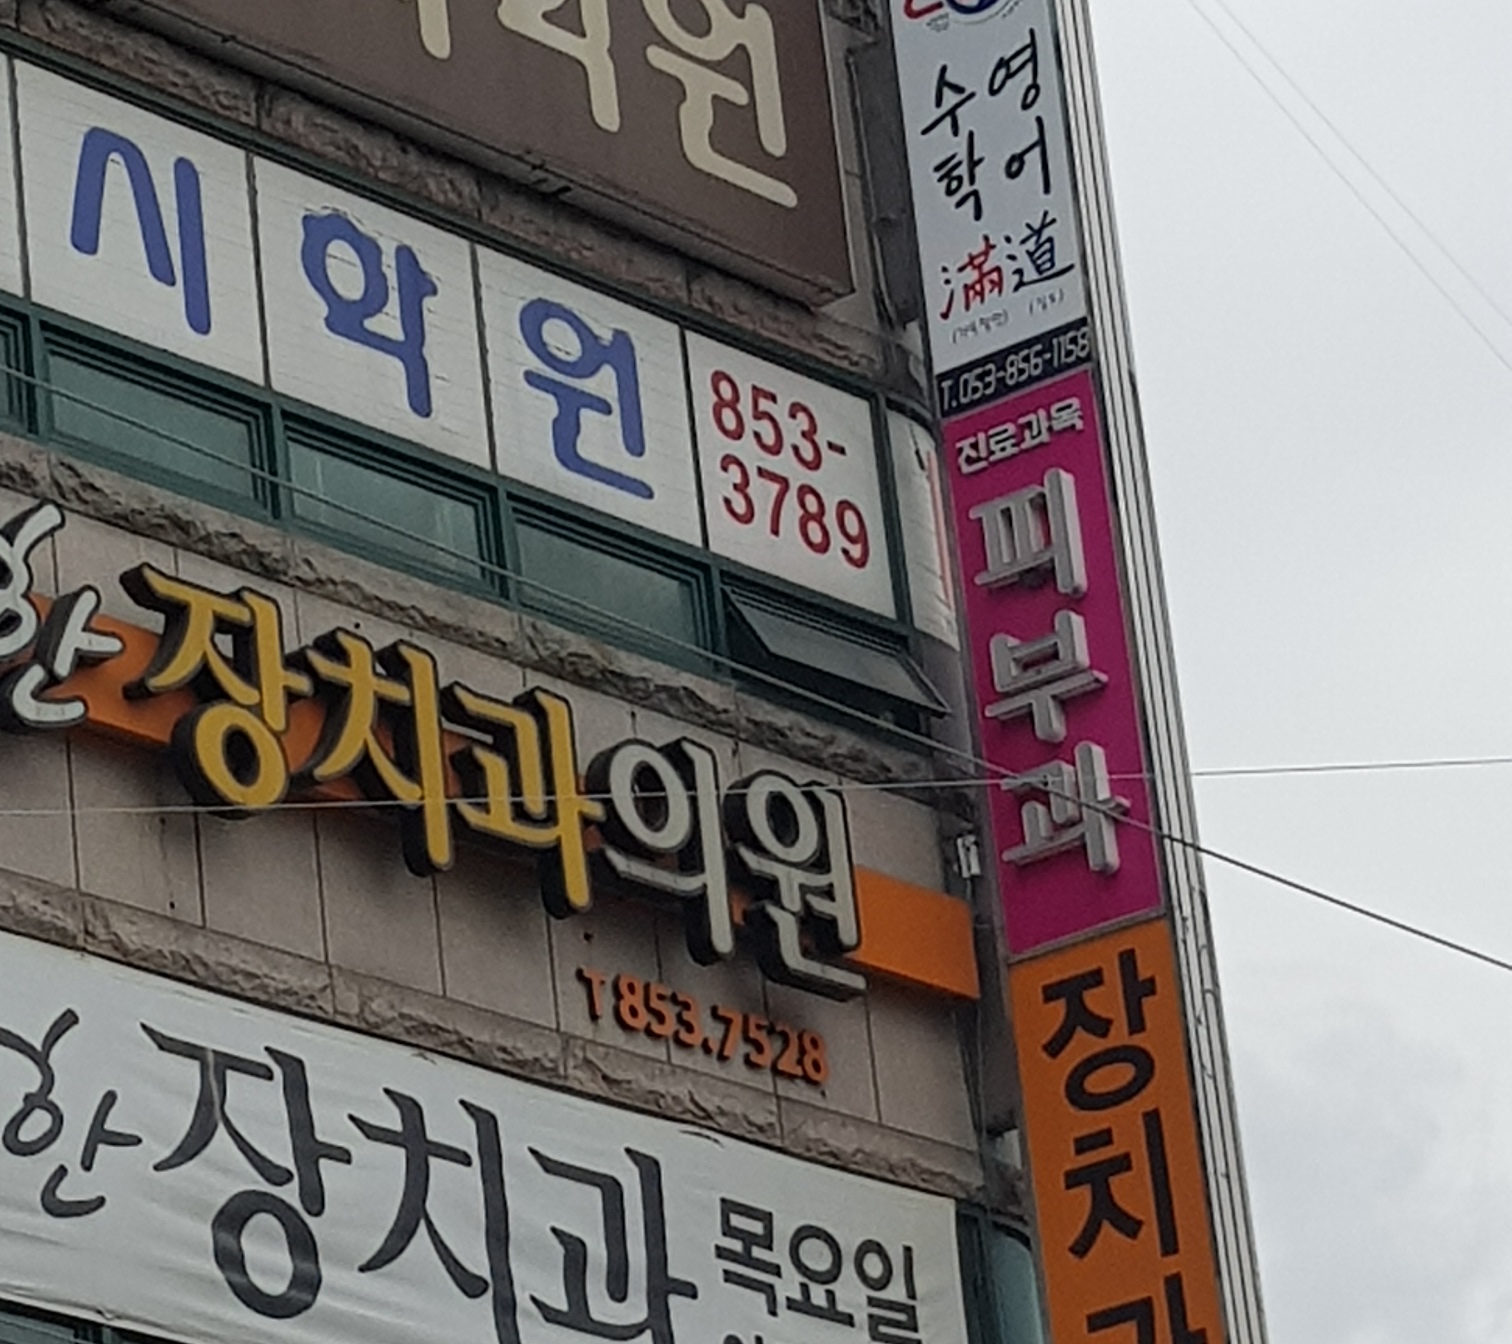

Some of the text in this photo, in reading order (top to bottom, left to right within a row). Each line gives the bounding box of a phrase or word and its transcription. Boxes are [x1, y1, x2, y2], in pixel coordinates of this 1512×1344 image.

[921, 64, 986, 222] 수학
[988, 27, 1052, 195] 영어
[720, 454, 872, 570] 3789
[956, 396, 1086, 476] 진료과목
[968, 467, 1132, 874] 피부과
